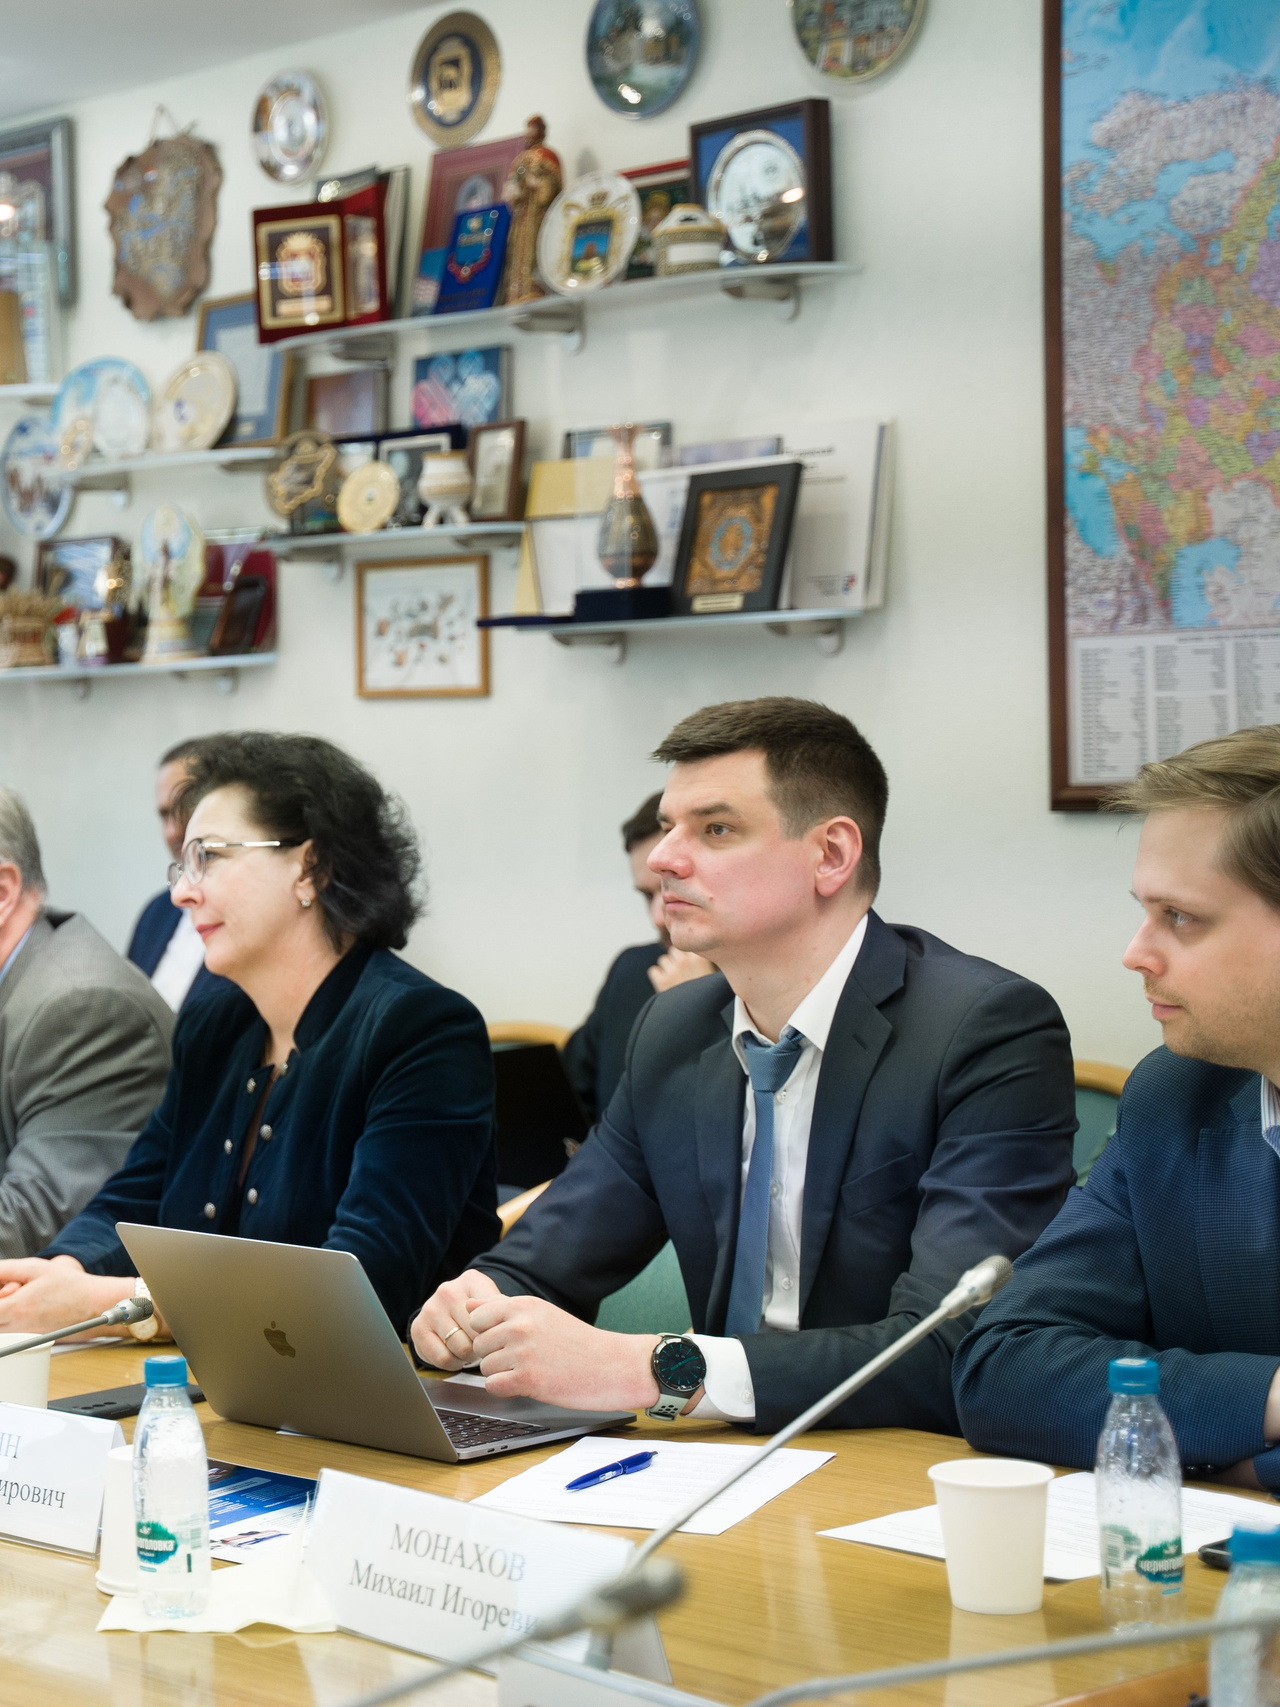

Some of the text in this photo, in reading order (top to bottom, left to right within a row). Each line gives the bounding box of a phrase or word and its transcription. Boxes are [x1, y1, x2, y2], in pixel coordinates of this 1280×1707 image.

[389, 1523, 527, 1583] МОНАХОВ
[348, 1558, 540, 1634] Михаил Игореви
